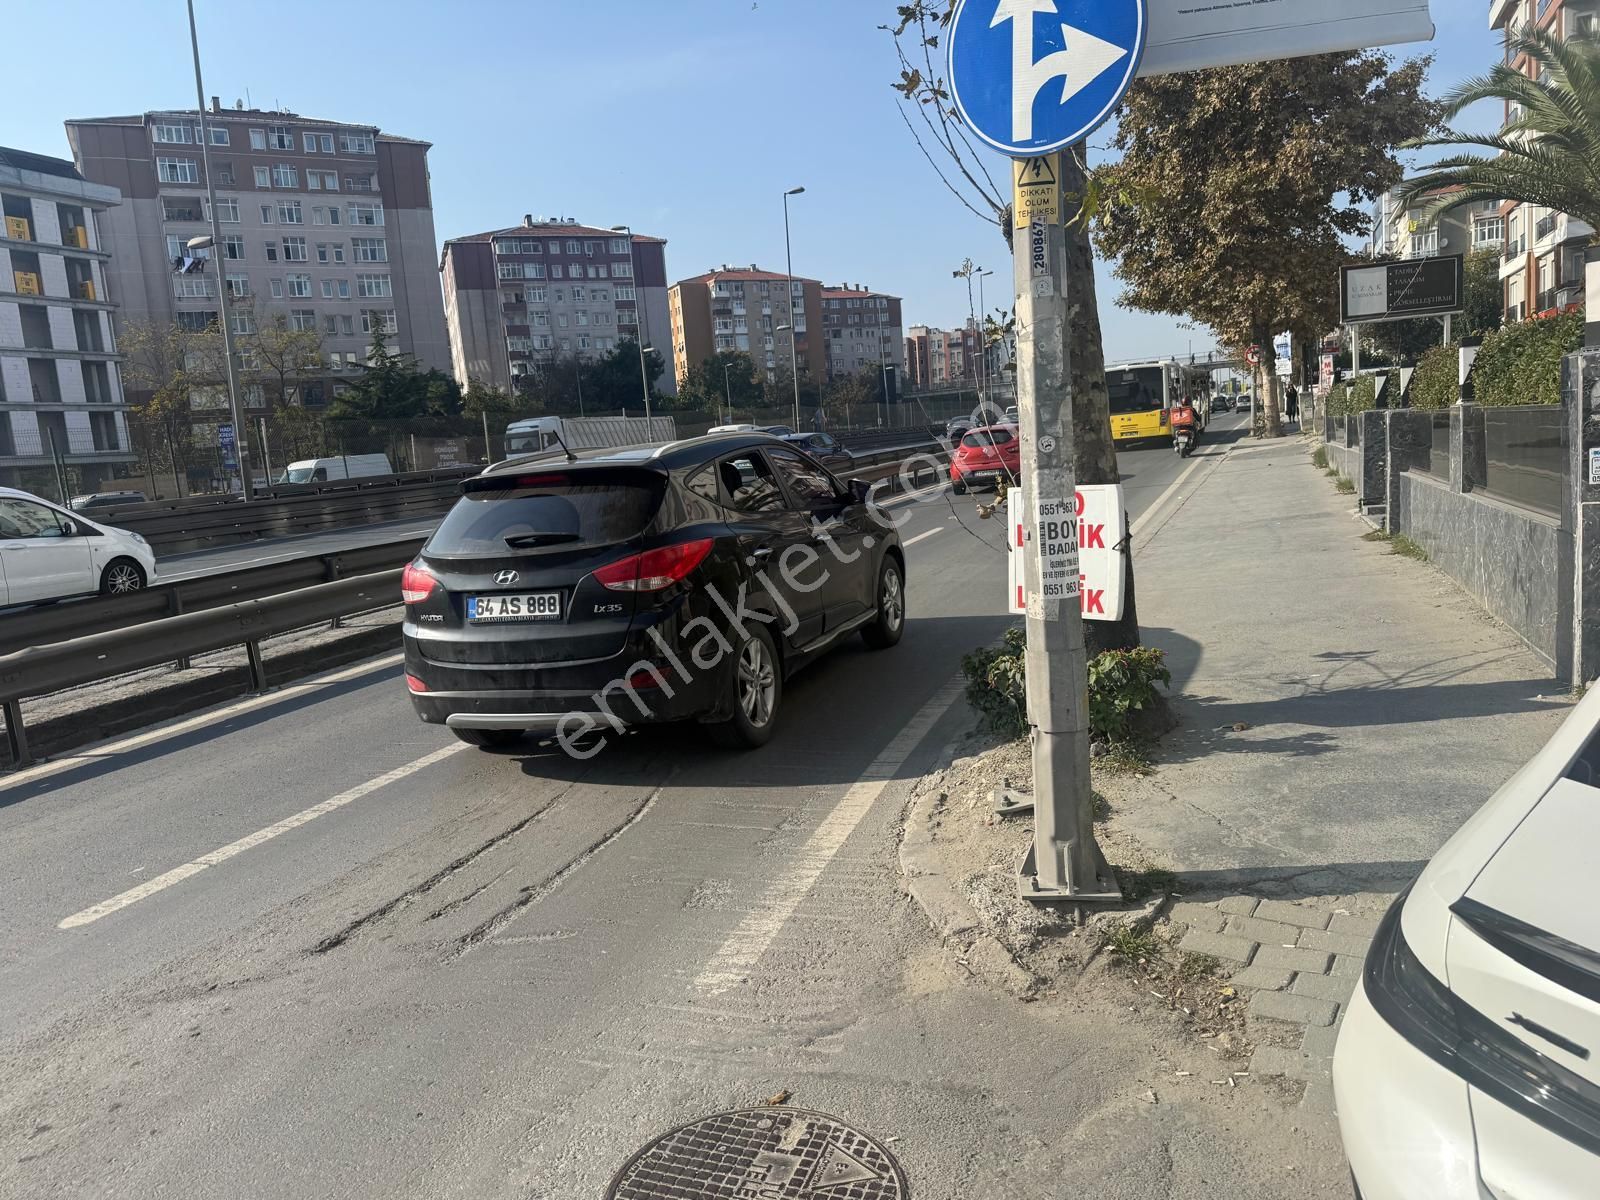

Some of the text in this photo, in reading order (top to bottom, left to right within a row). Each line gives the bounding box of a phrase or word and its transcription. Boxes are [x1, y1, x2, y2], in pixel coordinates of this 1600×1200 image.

[1033, 220, 1045, 269] 280867
[1040, 503, 1059, 516] 0551
[1043, 584, 1063, 596] 0551
[1065, 581, 1076, 594] 963
[476, 596, 557, 616] 64 AS 888
